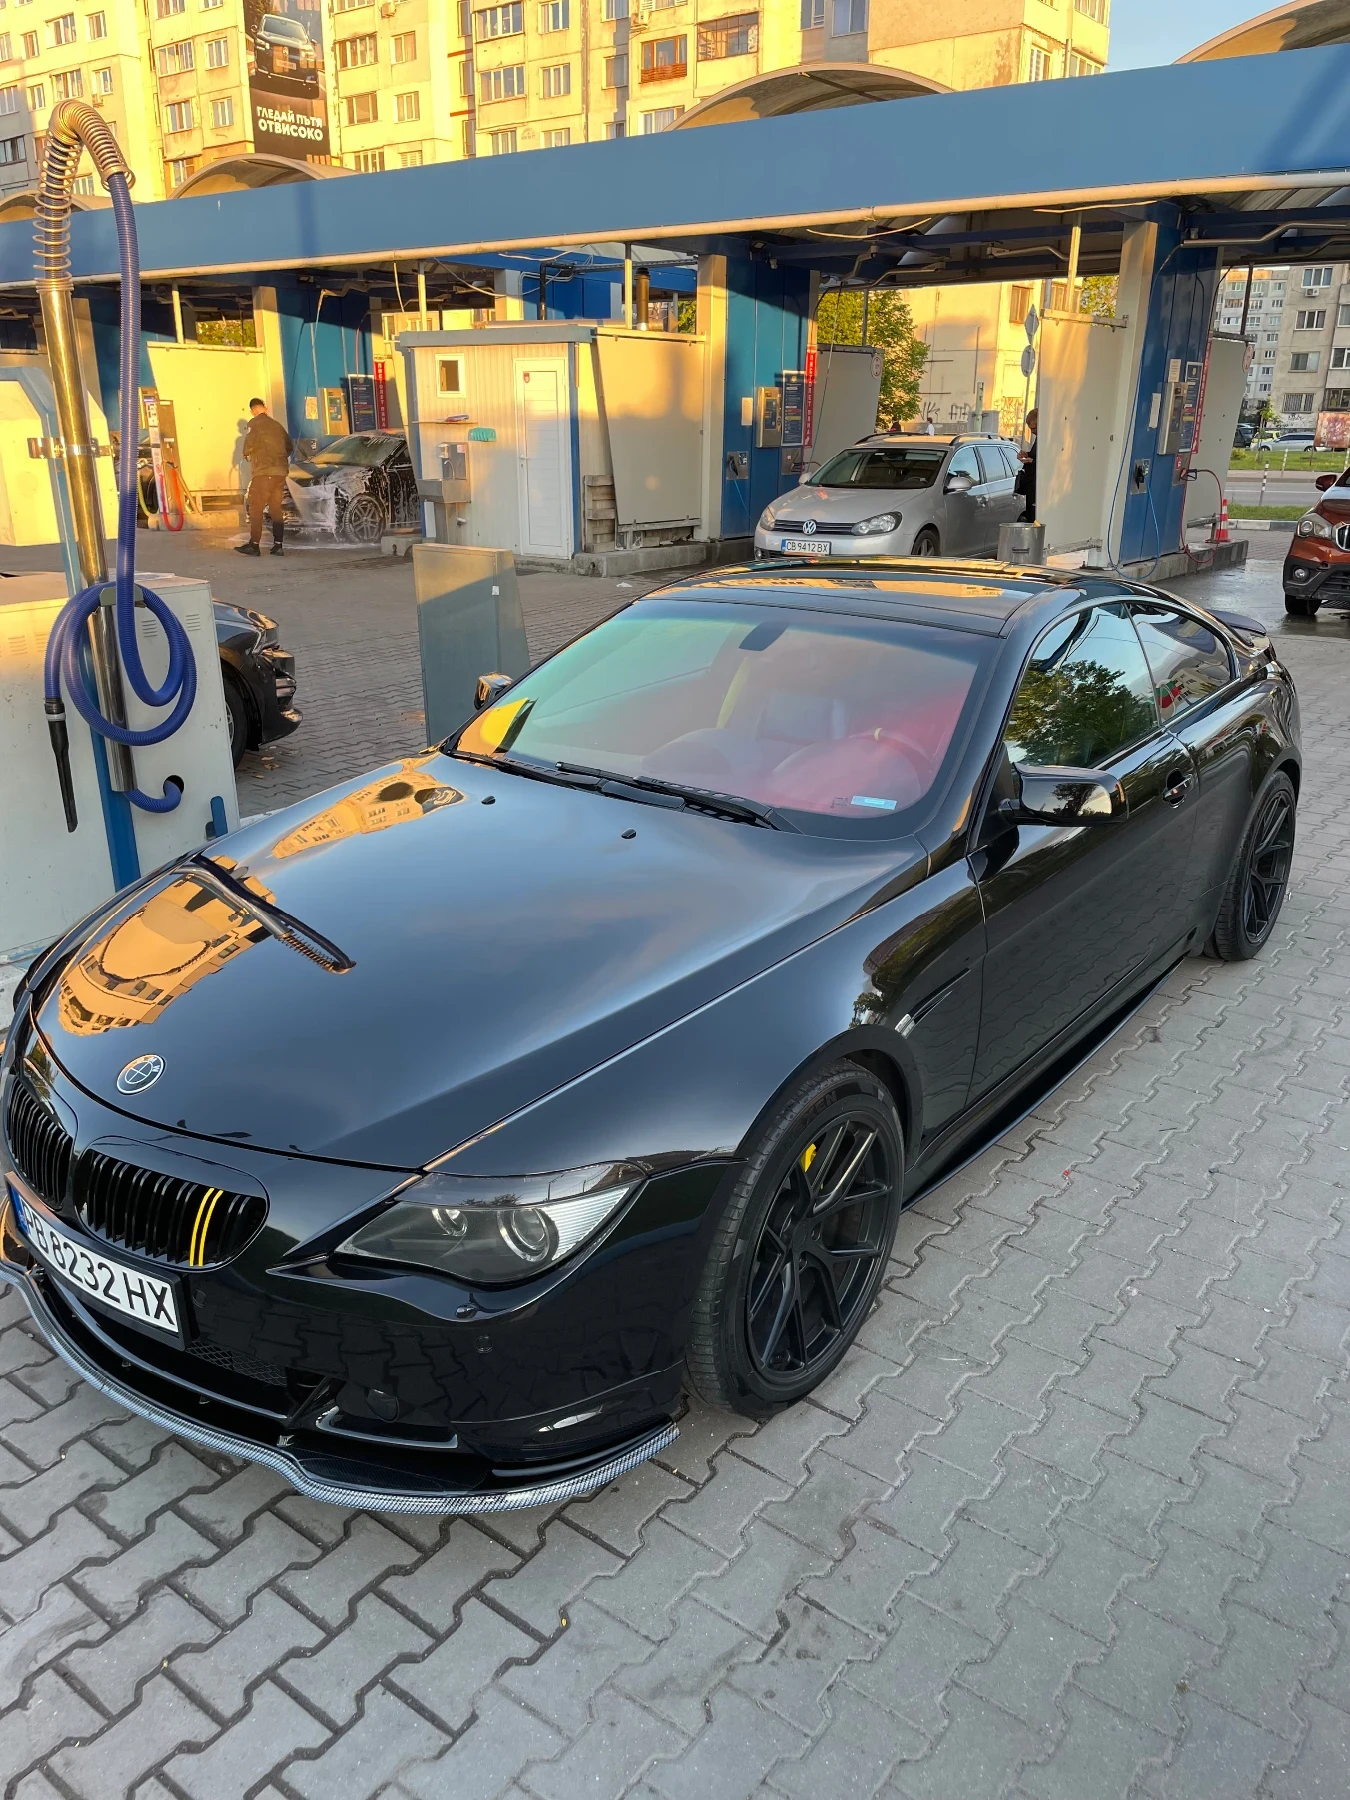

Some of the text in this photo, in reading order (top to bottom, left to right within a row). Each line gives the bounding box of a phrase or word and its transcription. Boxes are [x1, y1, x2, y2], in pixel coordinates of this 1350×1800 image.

[256, 106, 323, 128] ГЛЕДАЙ ПЪТЯ
[258, 118, 324, 141] ОТВИСОКО
[377, 362, 385, 405] ПИСТОЛЕТ
[786, 541, 828, 553] CB 9412 BX
[22, 1203, 176, 1326] PB 8232 HX
